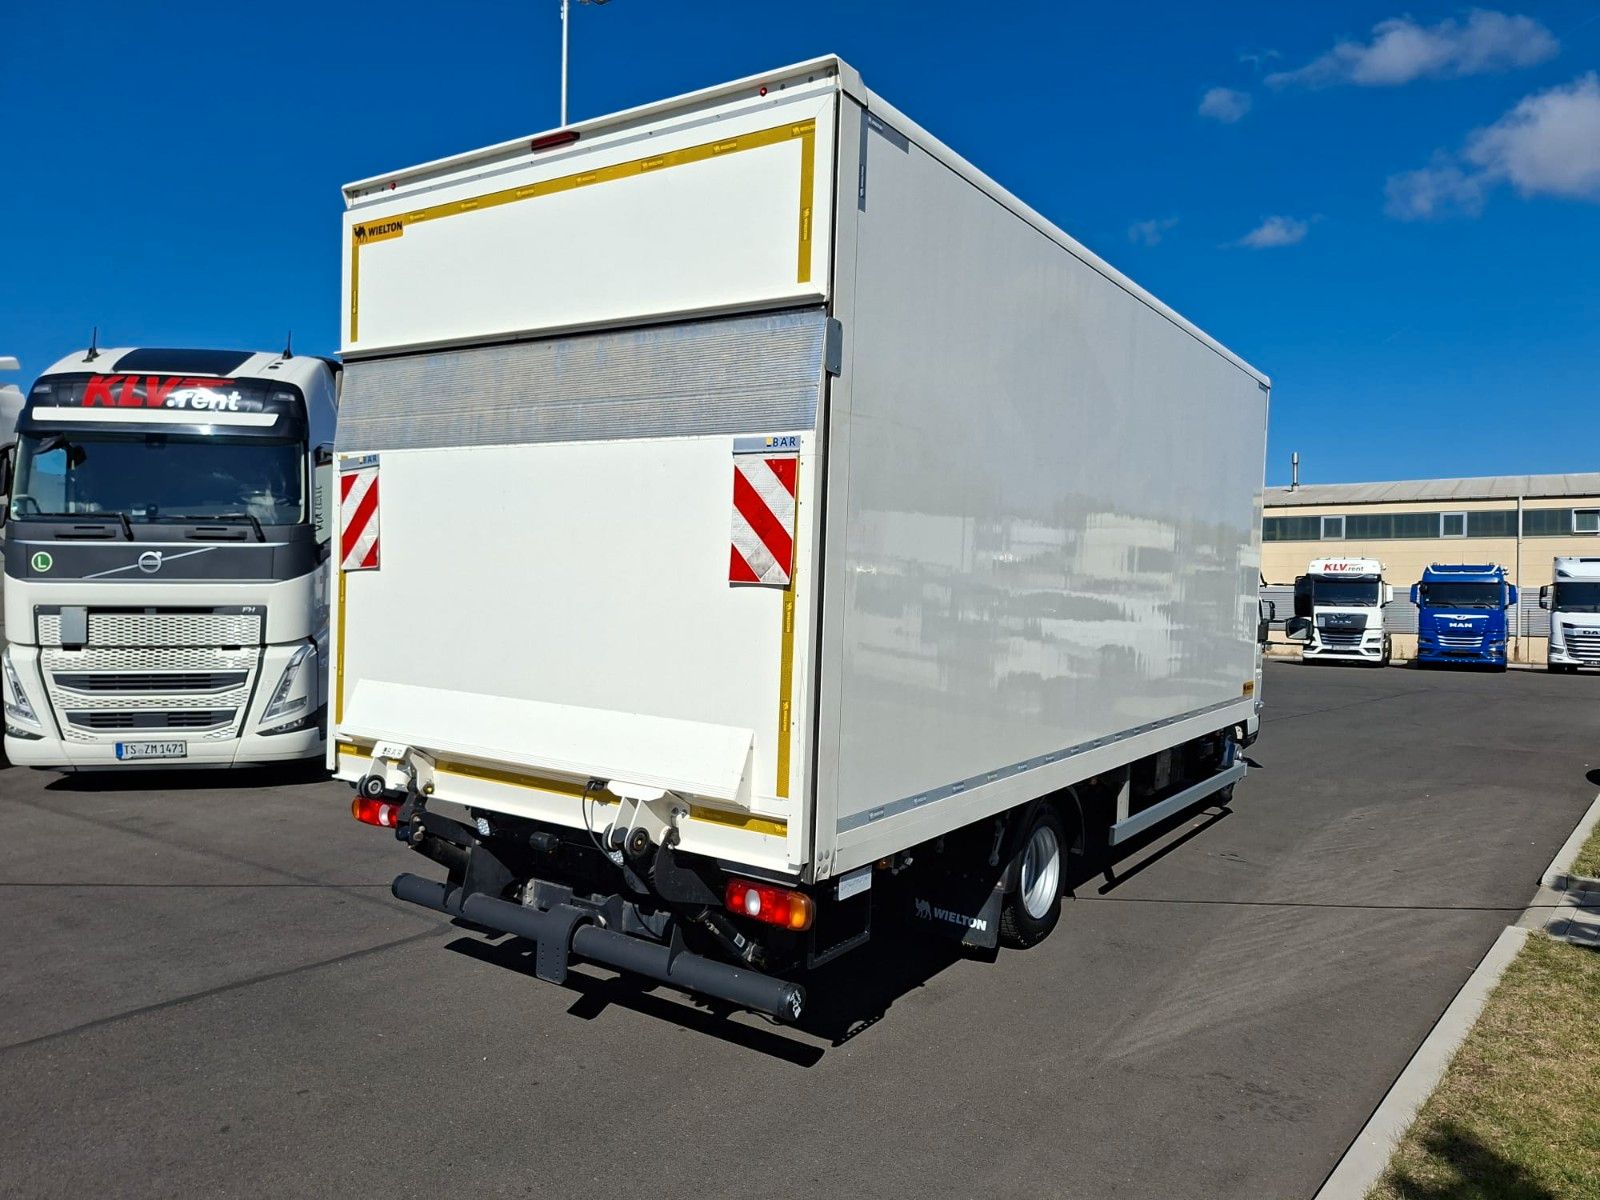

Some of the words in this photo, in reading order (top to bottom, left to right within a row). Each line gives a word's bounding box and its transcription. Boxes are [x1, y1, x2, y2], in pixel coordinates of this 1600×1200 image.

[368, 221, 403, 237] WIELTON
[81, 375, 242, 411] KLV.rent
[125, 744, 136, 755] TS
[145, 744, 158, 754] ZM
[160, 743, 184, 754] 1471
[934, 906, 988, 932] WIELTON
